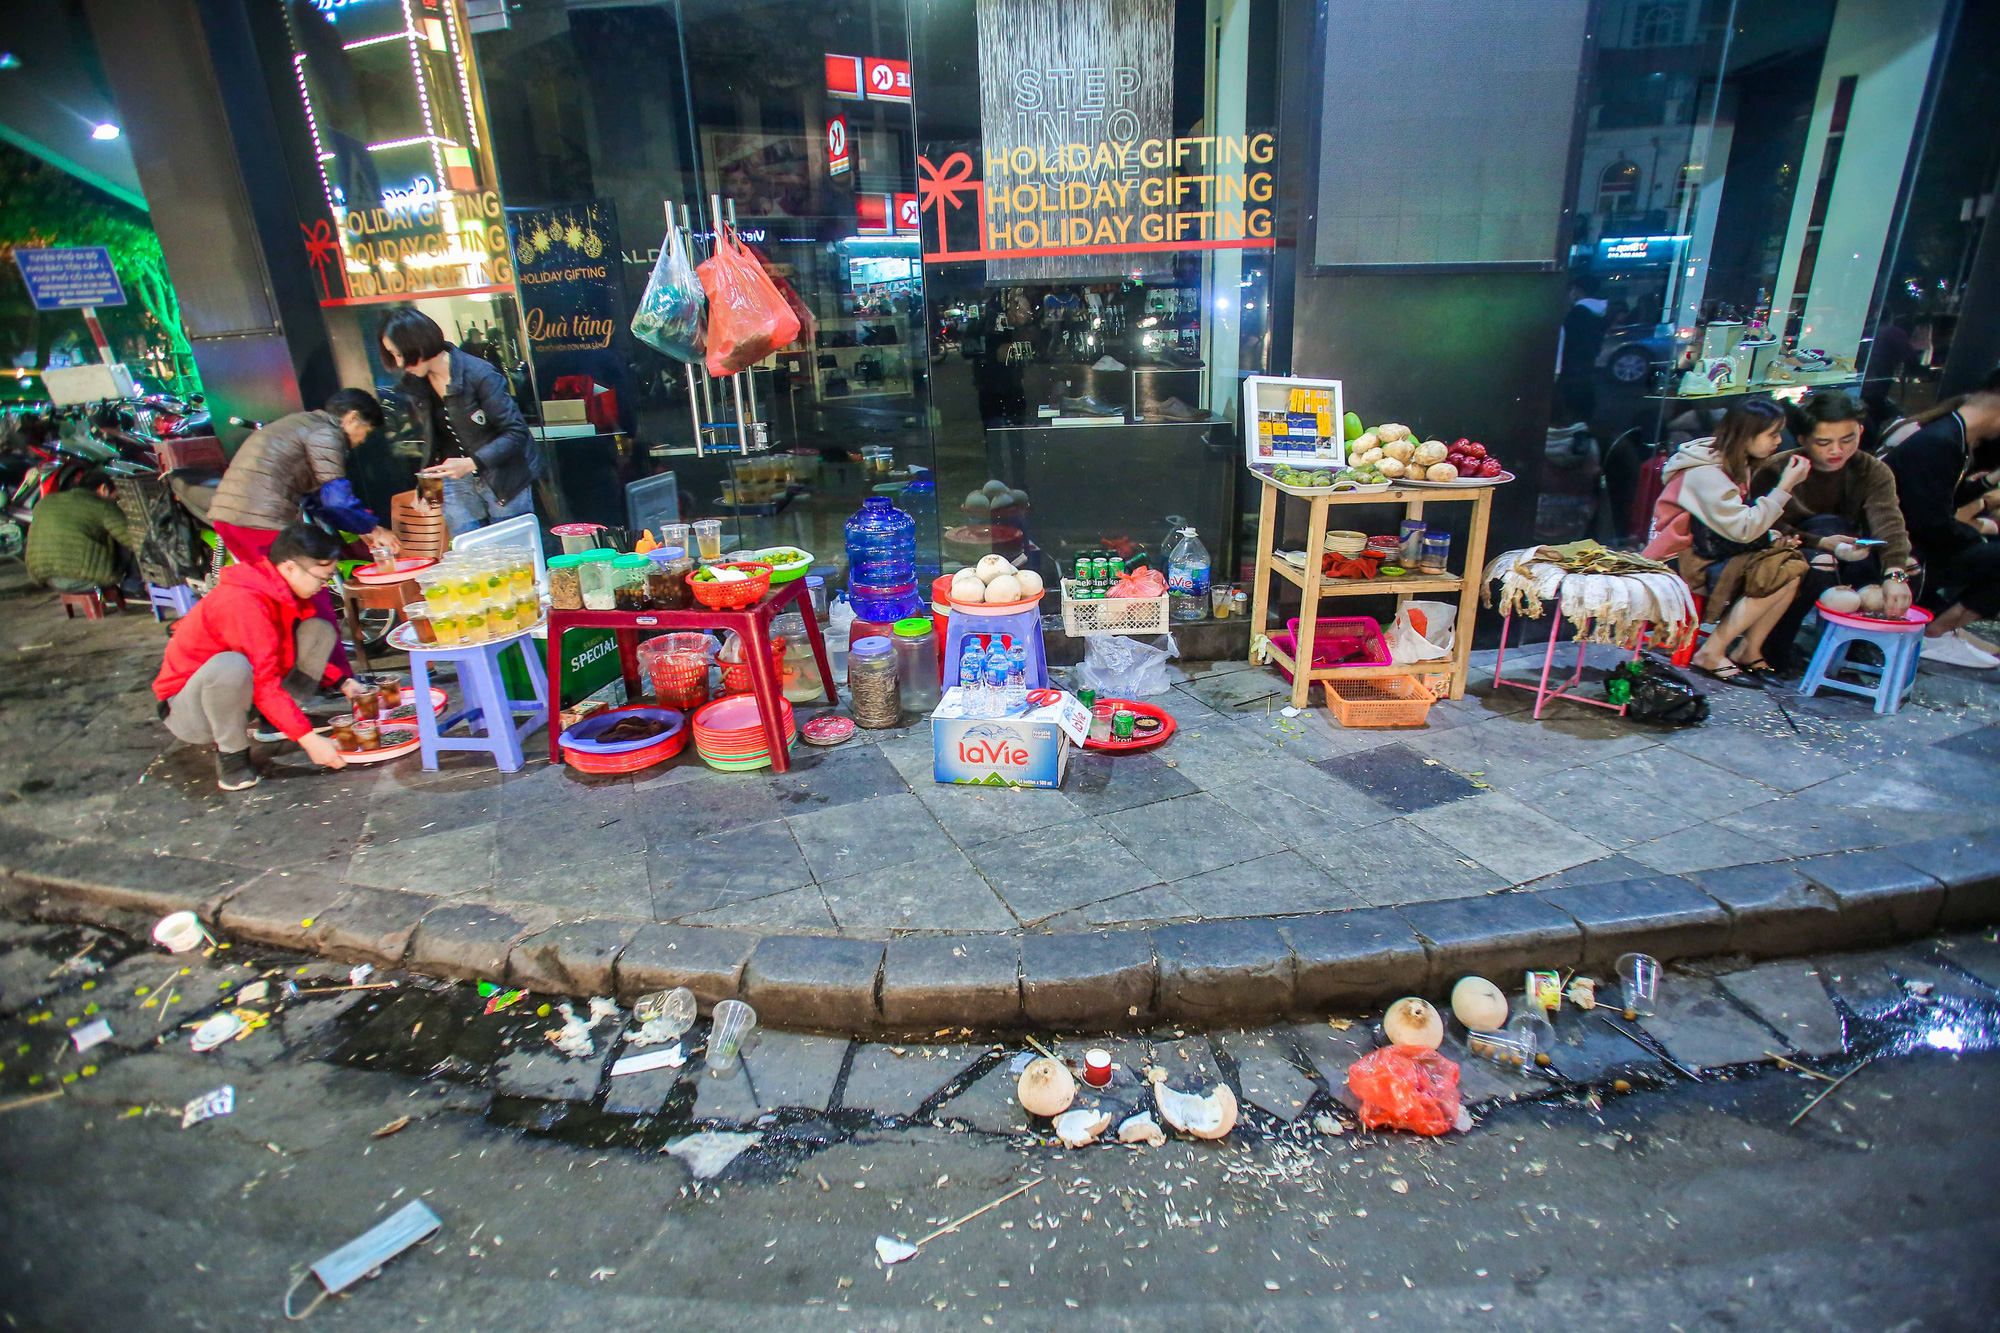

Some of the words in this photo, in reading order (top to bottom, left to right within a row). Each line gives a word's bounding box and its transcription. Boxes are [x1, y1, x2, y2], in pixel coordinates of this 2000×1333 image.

[1015, 67, 1141, 110] STEP
[1017, 109, 1141, 150] INTO
[985, 141, 1133, 176] HOLIDAY
[1140, 133, 1274, 168] GIFTING
[988, 180, 1132, 214] HOLIDAY
[1140, 172, 1273, 207] GIFTING
[424, 225, 506, 257] GIFTING
[989, 215, 1134, 249] HOLIDAY
[1140, 208, 1272, 242] GIFTING
[520, 270, 562, 284] HOLIDAY
[564, 266, 606, 281] GIFTING
[621, 248, 660, 264] ALD
[348, 266, 427, 298] HOLIDAY
[431, 257, 511, 288] GIFTING
[526, 308, 568, 341] Quà
[573, 314, 616, 348] tặng
[1170, 576, 1193, 588] aVie
[570, 637, 618, 672] SPECIAL
[958, 740, 1028, 766] laVie
